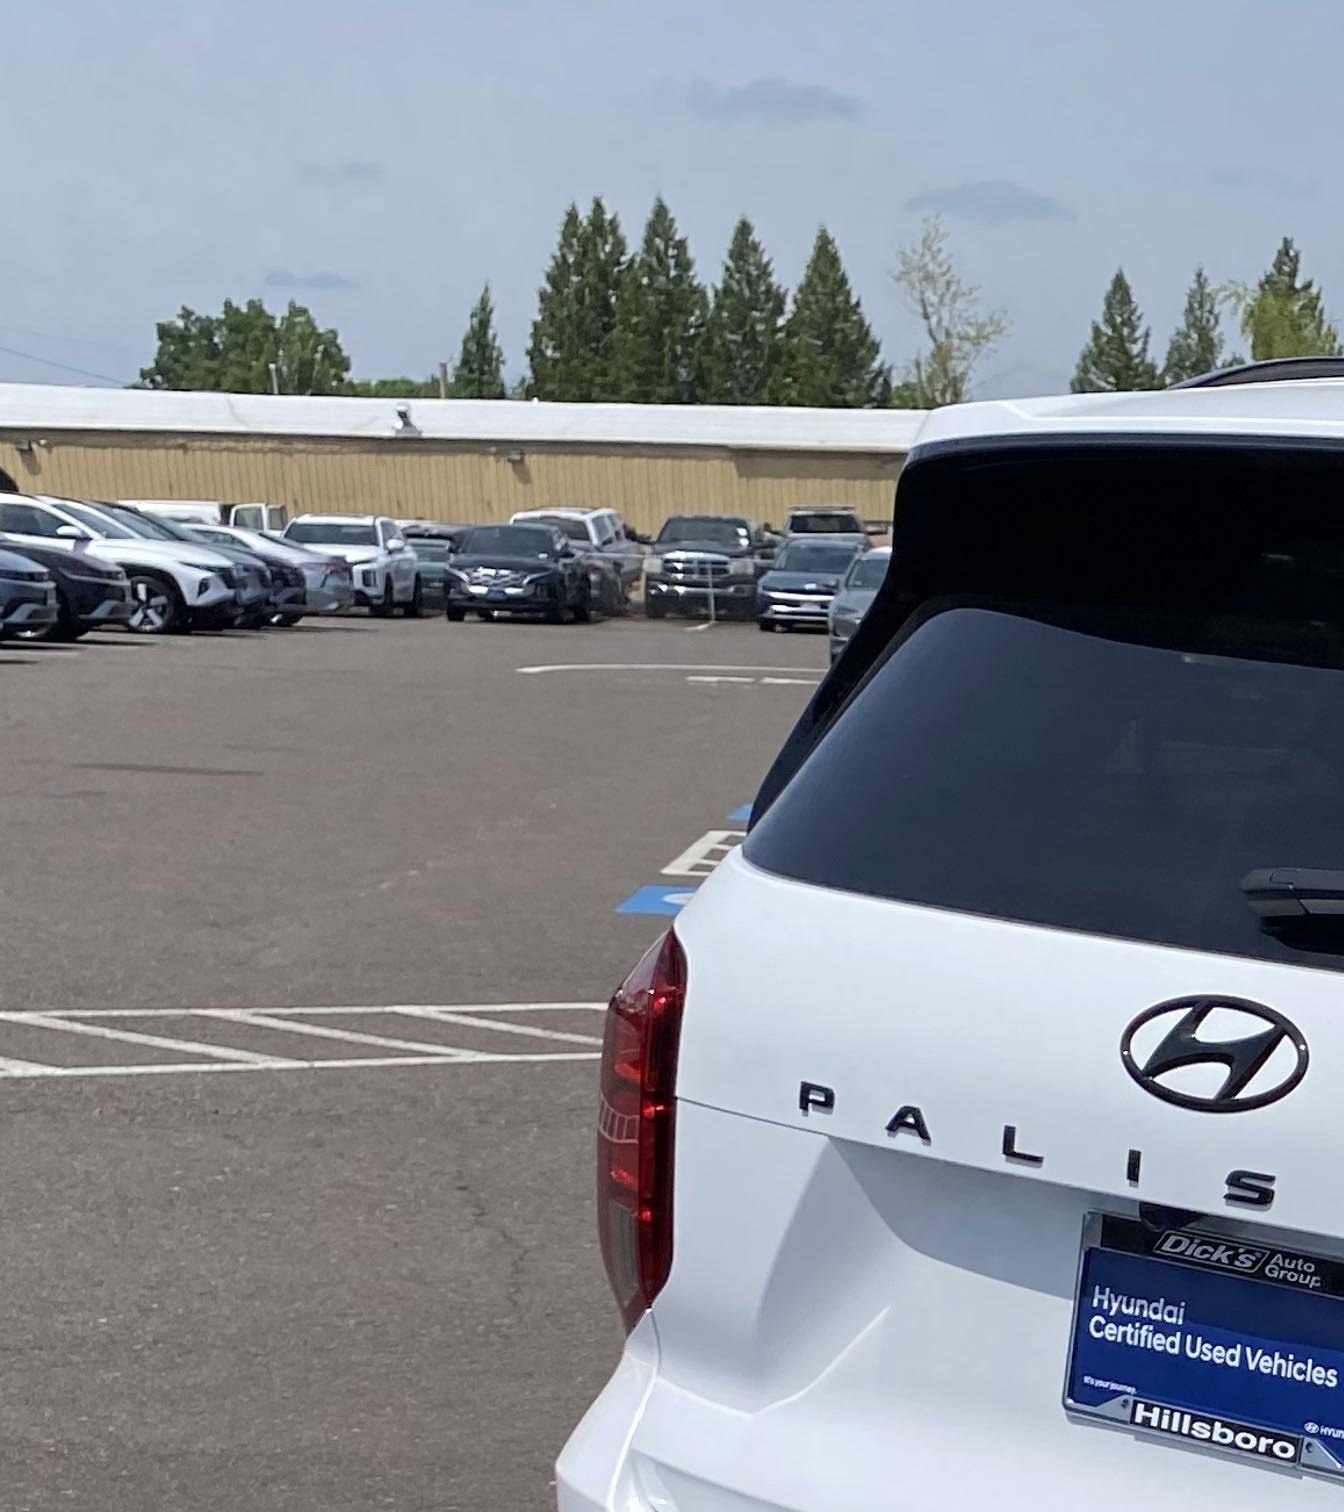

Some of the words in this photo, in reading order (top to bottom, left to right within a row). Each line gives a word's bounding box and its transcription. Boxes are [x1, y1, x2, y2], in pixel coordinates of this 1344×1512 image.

[1160, 1234, 1257, 1269] Dick's
[1269, 1253, 1315, 1273] Auto
[1264, 1264, 1322, 1289] Group
[1092, 1285, 1186, 1326] Hyundai
[1089, 1314, 1181, 1355] Certified
[1184, 1333, 1242, 1368] Used
[1245, 1345, 1339, 1388] Vehicles
[1133, 1403, 1296, 1460] Hillsboro
